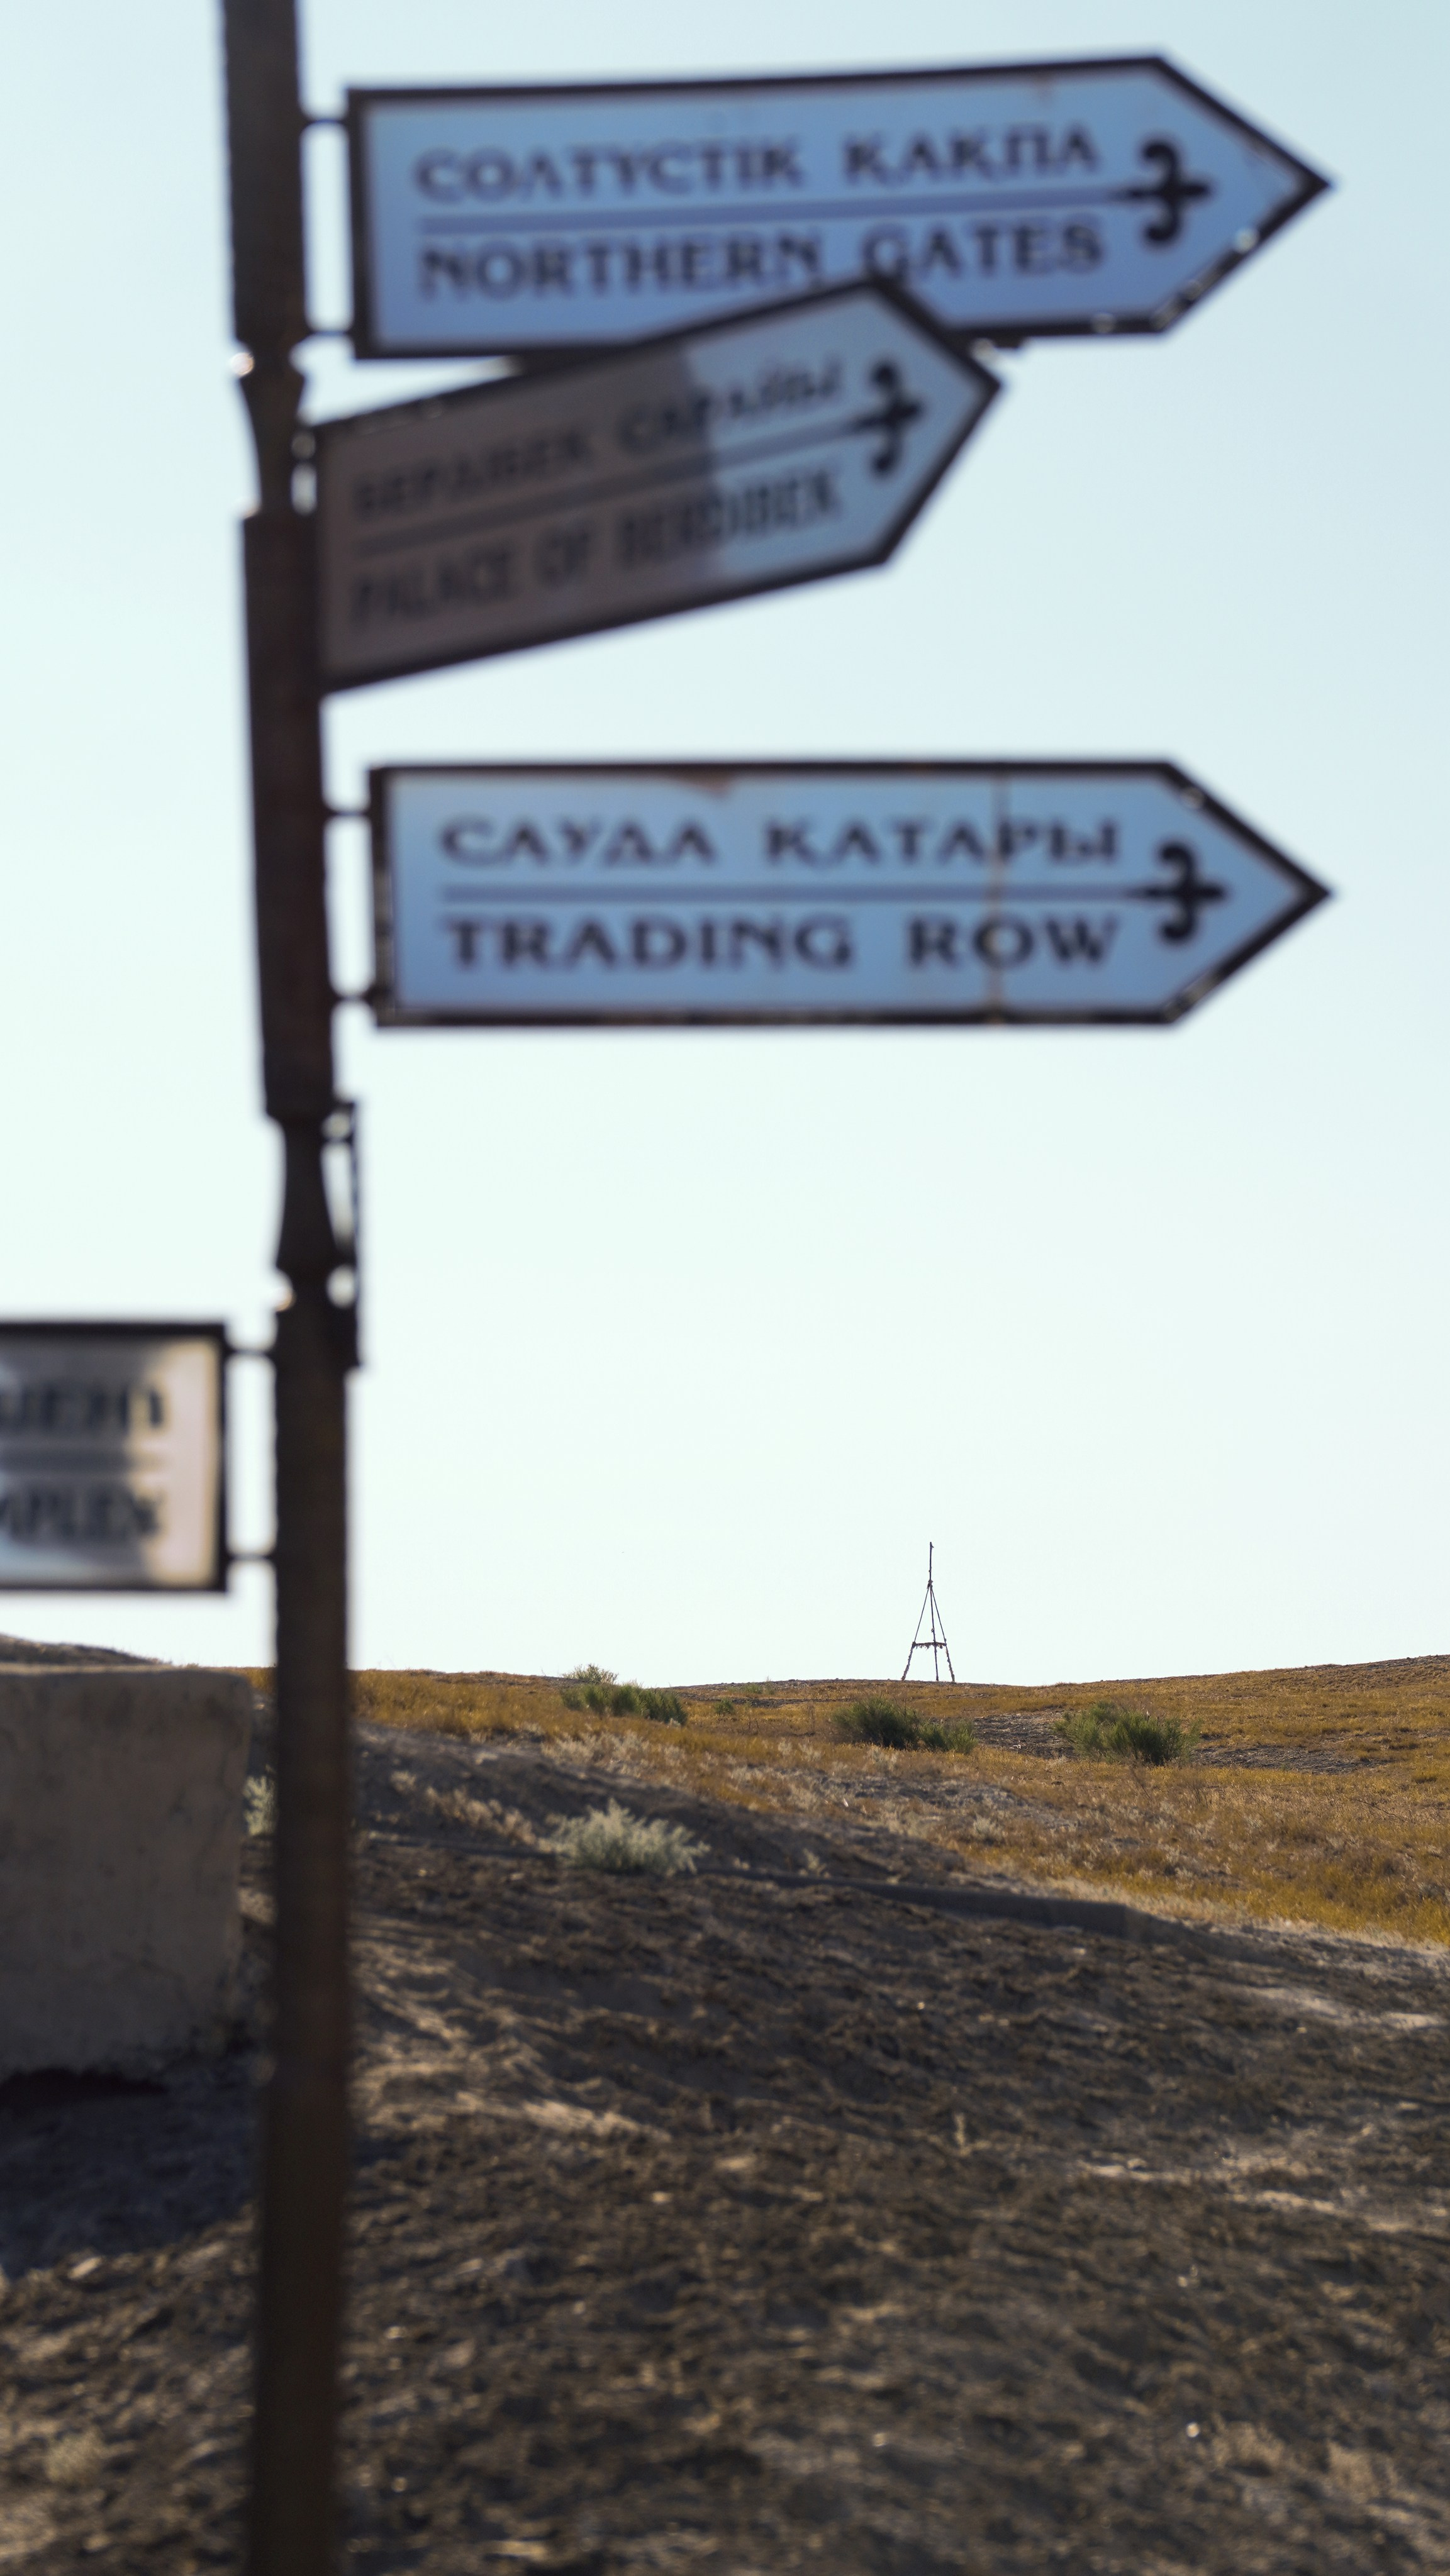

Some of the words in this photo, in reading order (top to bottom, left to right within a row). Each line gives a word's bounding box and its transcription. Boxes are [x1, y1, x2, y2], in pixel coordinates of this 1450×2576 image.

[417, 225, 823, 303] NORTHERN
[859, 214, 1107, 283] GATES
[349, 538, 516, 623] PALACE
[532, 518, 593, 587] OF
[439, 911, 854, 970] TRADING
[906, 911, 1122, 970] ROW
